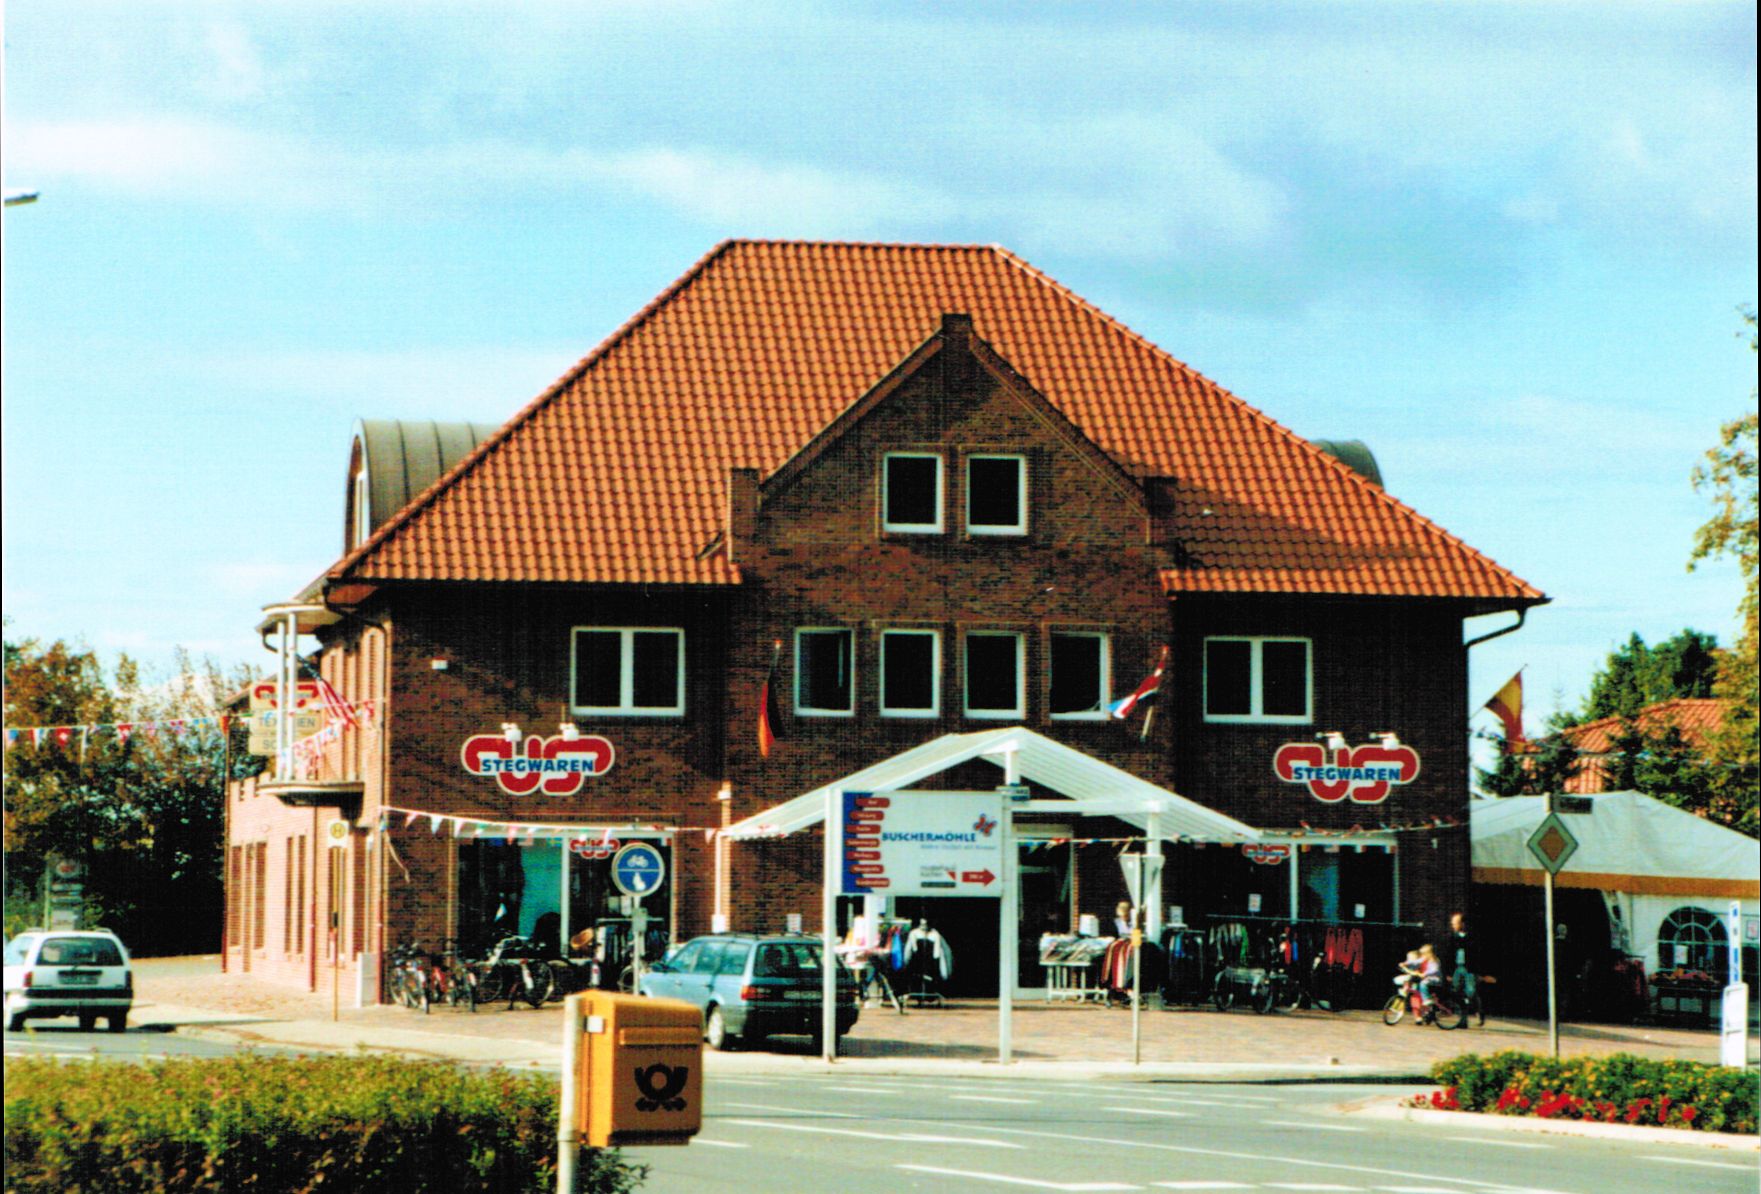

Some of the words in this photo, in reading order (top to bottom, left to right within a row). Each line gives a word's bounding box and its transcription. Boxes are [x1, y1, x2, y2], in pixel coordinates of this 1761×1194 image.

[482, 758, 594, 772] STEGWAREN
[1293, 767, 1401, 780] STEGWAREN
[881, 831, 977, 842] BUSCHERMÖHLE
